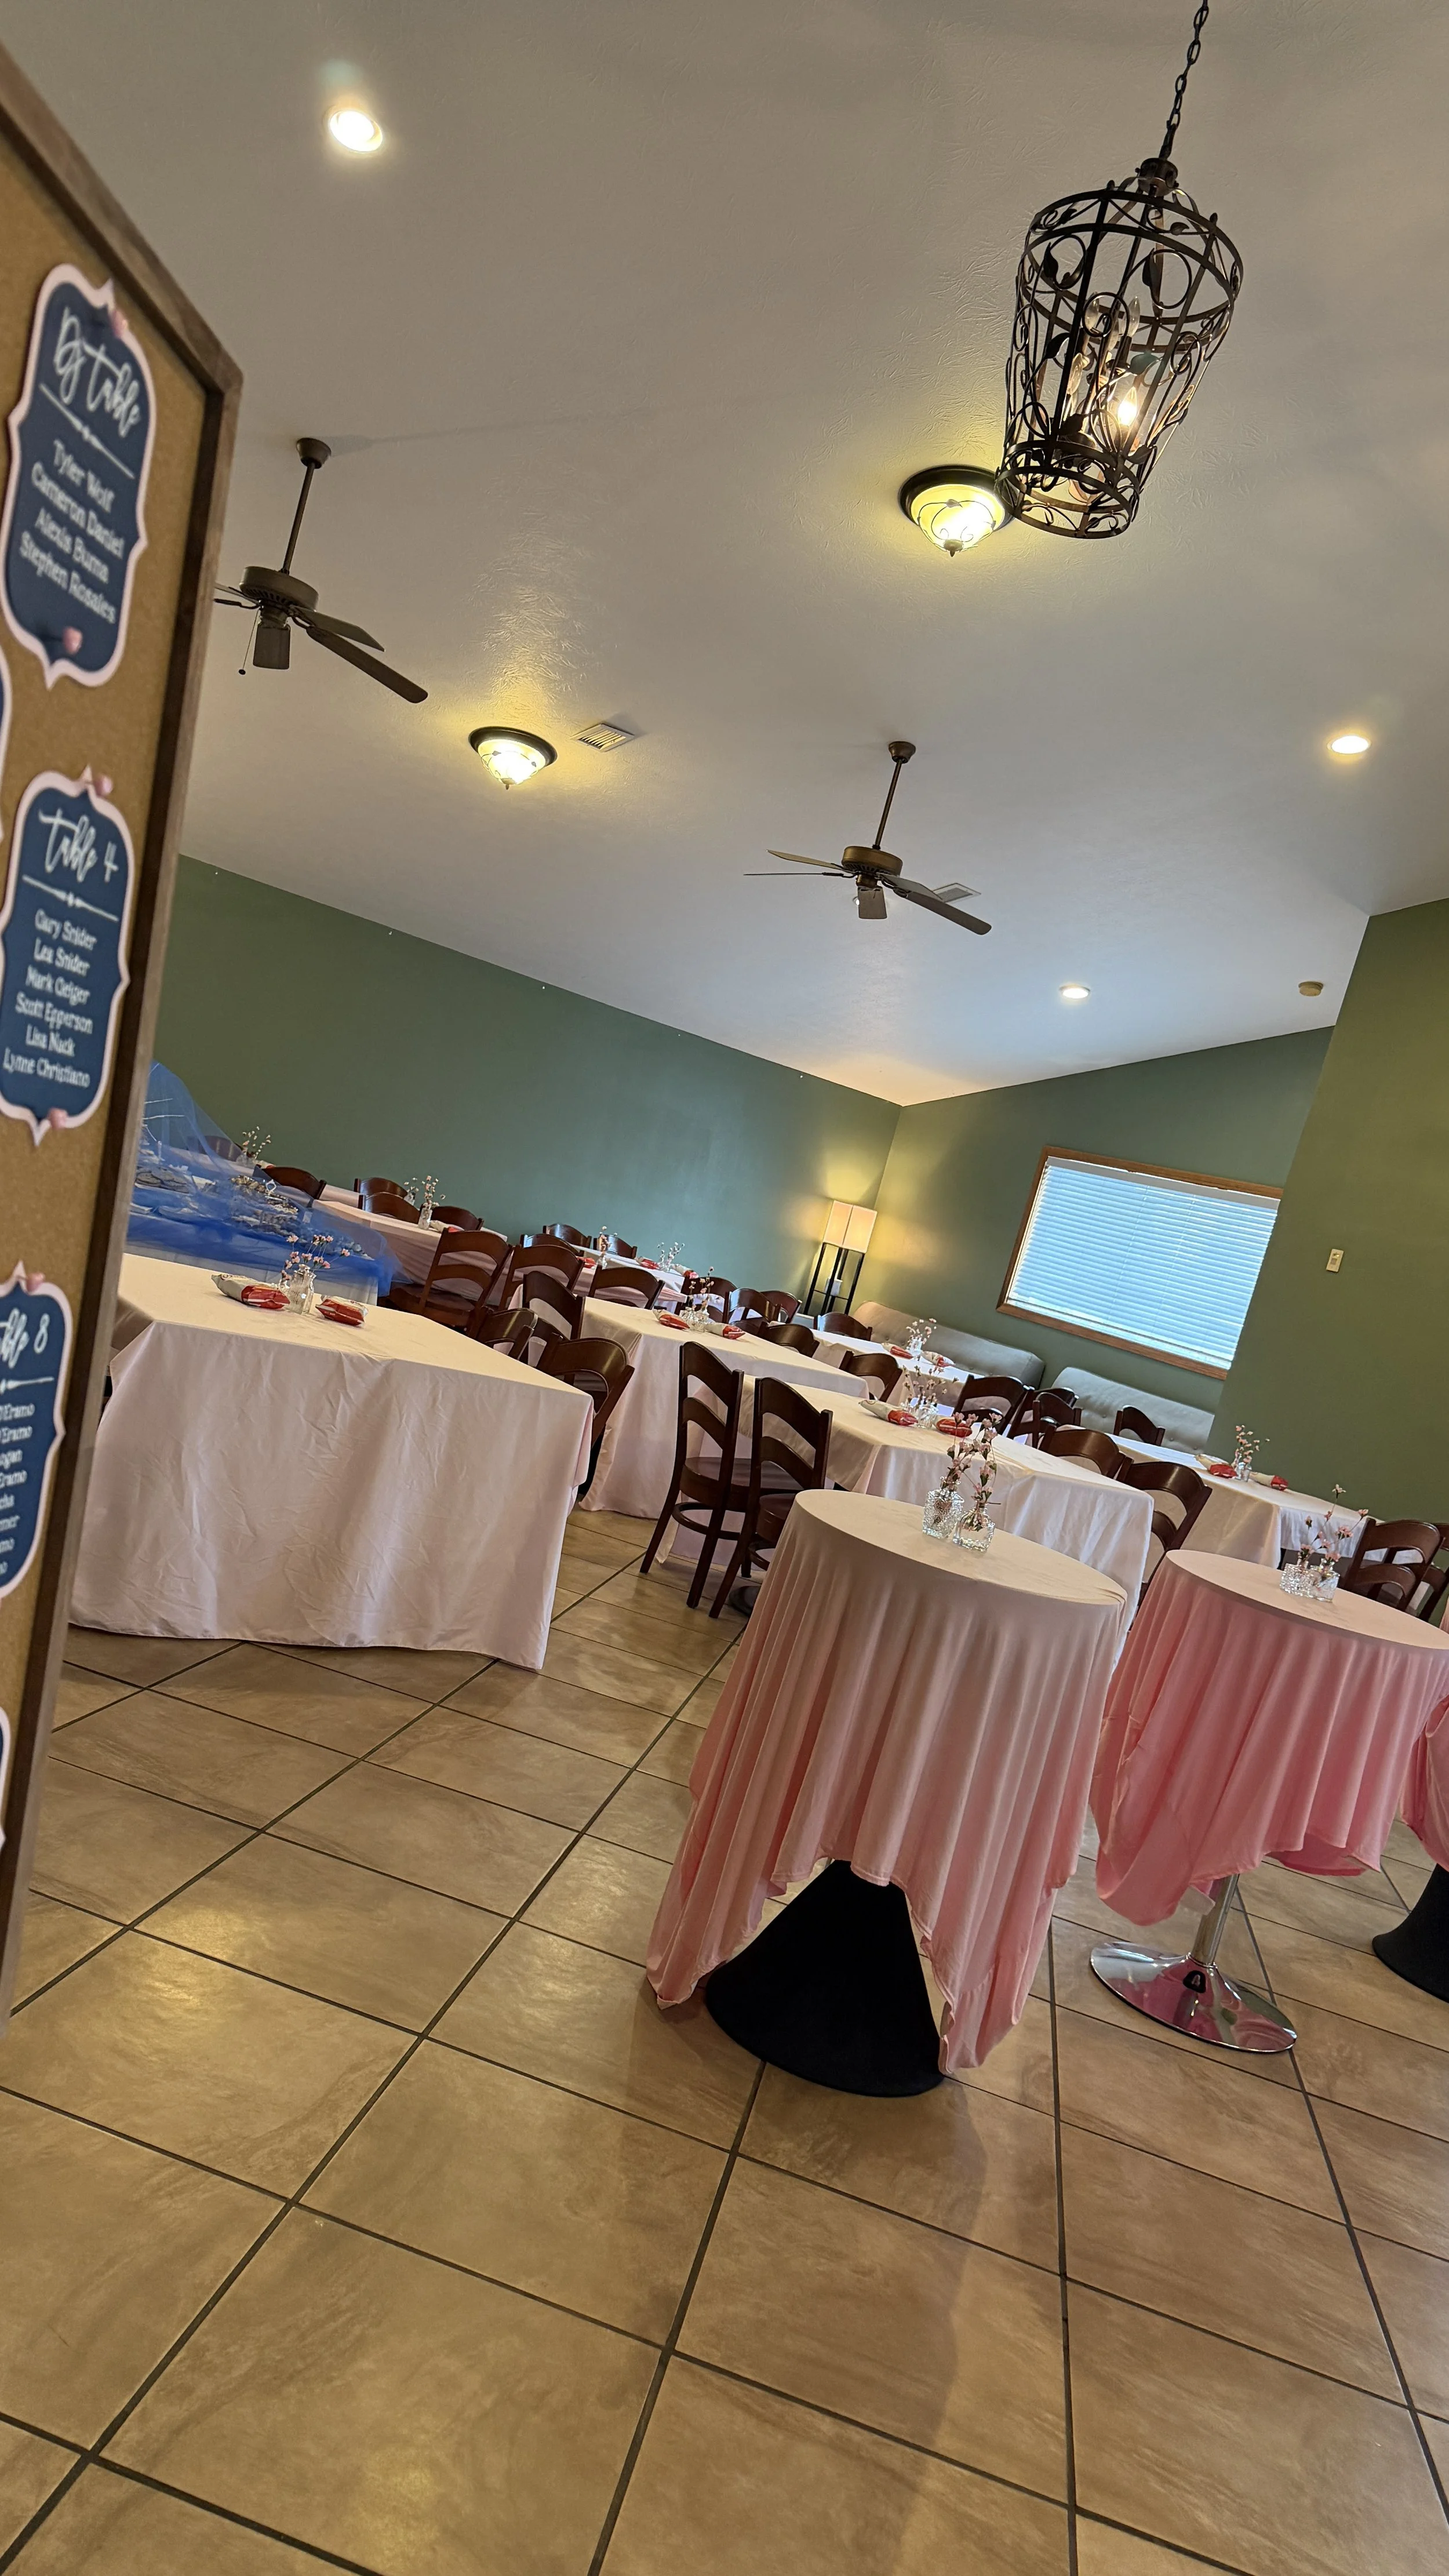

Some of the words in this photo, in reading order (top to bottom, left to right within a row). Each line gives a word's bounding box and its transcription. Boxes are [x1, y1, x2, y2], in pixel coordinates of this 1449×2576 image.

[53, 439, 85, 486] Tyler
[87, 469, 115, 514] Wolf
[31, 461, 86, 530] Cameron
[86, 509, 125, 560] Daniel
[35, 507, 73, 554] Alexis
[20, 530, 69, 590] Stephen
[68, 570, 116, 624] Rosales
[104, 841, 119, 883] 4
[35, 908, 63, 940] Gary
[62, 920, 97, 951] Snider
[55, 947, 90, 977] Snider
[26, 965, 54, 994] Mark
[54, 976, 90, 1006] Geiger
[15, 992, 45, 1018] Scott
[44, 1002, 93, 1035] Epperson
[26, 1024, 48, 1050] Lisa
[34, 1312, 50, 1354] 8
